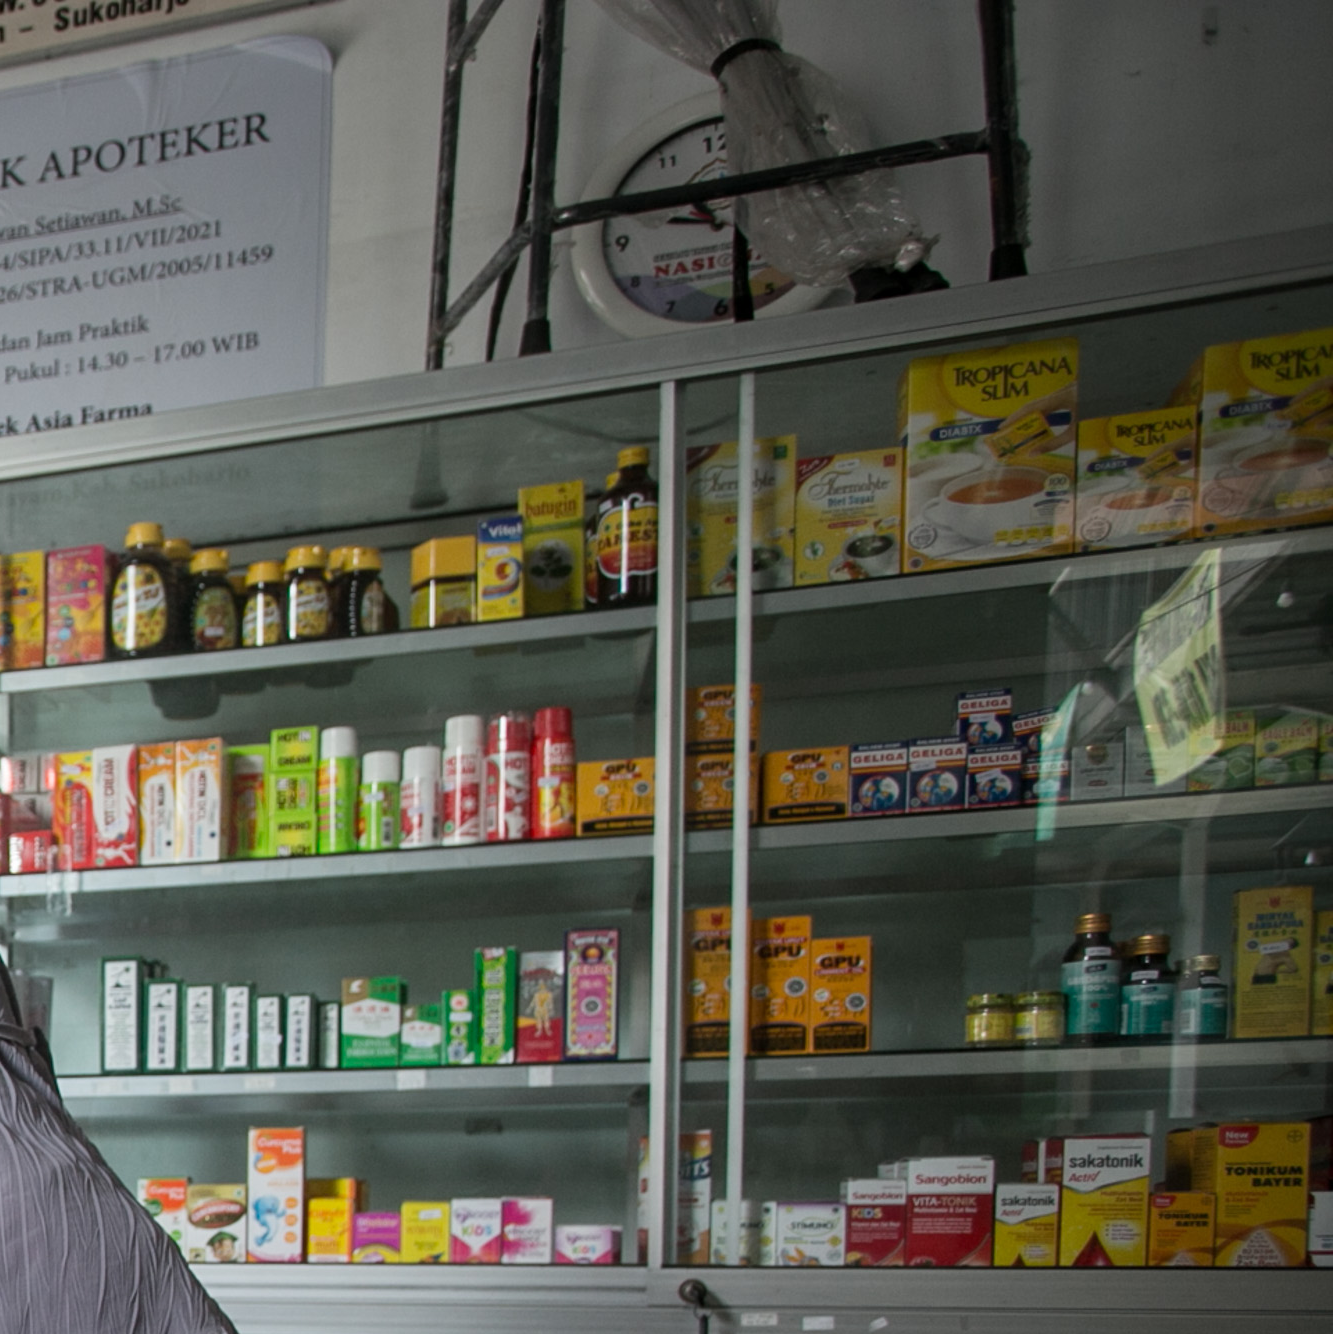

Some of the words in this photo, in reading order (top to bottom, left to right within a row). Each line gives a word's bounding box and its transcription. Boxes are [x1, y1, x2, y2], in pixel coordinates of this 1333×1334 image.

[38, 111, 272, 184] APOTEKER
[658, 154, 677, 169] 11
[132, 193, 184, 220] M.Sc
[614, 234, 631, 253] 9
[713, 298, 729, 317] 6
[36, 327, 73, 351] Jam
[78, 314, 150, 343] Praktik
[4, 359, 60, 384] Pukul
[77, 350, 129, 374] 14.30
[153, 340, 206, 365] 17.00
[211, 331, 261, 354] WIB
[952, 353, 1074, 391] TROPICANA
[1274, 352, 1321, 382] SLIM
[980, 366, 1030, 404] SLIM
[1227, 400, 1274, 417] DIABTX
[24, 408, 74, 433] Asia
[81, 401, 154, 424] Farma
[937, 423, 983, 440] DIABTX
[1115, 417, 1194, 444] TROPICANA
[1132, 428, 1167, 449] SLIM
[1093, 458, 1129, 473] DIABTX
[524, 493, 579, 523] batugin
[827, 496, 849, 510] Diet
[959, 698, 1011, 711] GELIGA
[788, 751, 824, 766] GPU
[853, 752, 908, 765] GELIGA
[911, 747, 966, 761] GELIGA
[968, 752, 1021, 765] GELIGA
[756, 943, 803, 960] GPU
[819, 954, 863, 970] GPU
[1224, 1129, 1249, 1140] New
[1068, 1153, 1144, 1170] sakatonik
[1224, 1165, 1304, 1177] TONIKUM
[914, 1172, 990, 1188] Sangobion
[1252, 1177, 1304, 1188] BAYER
[852, 1190, 907, 1202] Sangobion
[912, 1195, 978, 1209] VITA-TONIK
[1000, 1195, 1056, 1208] sakatonik
[850, 1207, 884, 1219] KIDS
[1157, 1213, 1210, 1222] TONIKUM
[461, 1224, 494, 1238] KIDS
[1175, 1220, 1210, 1228] BAYER
